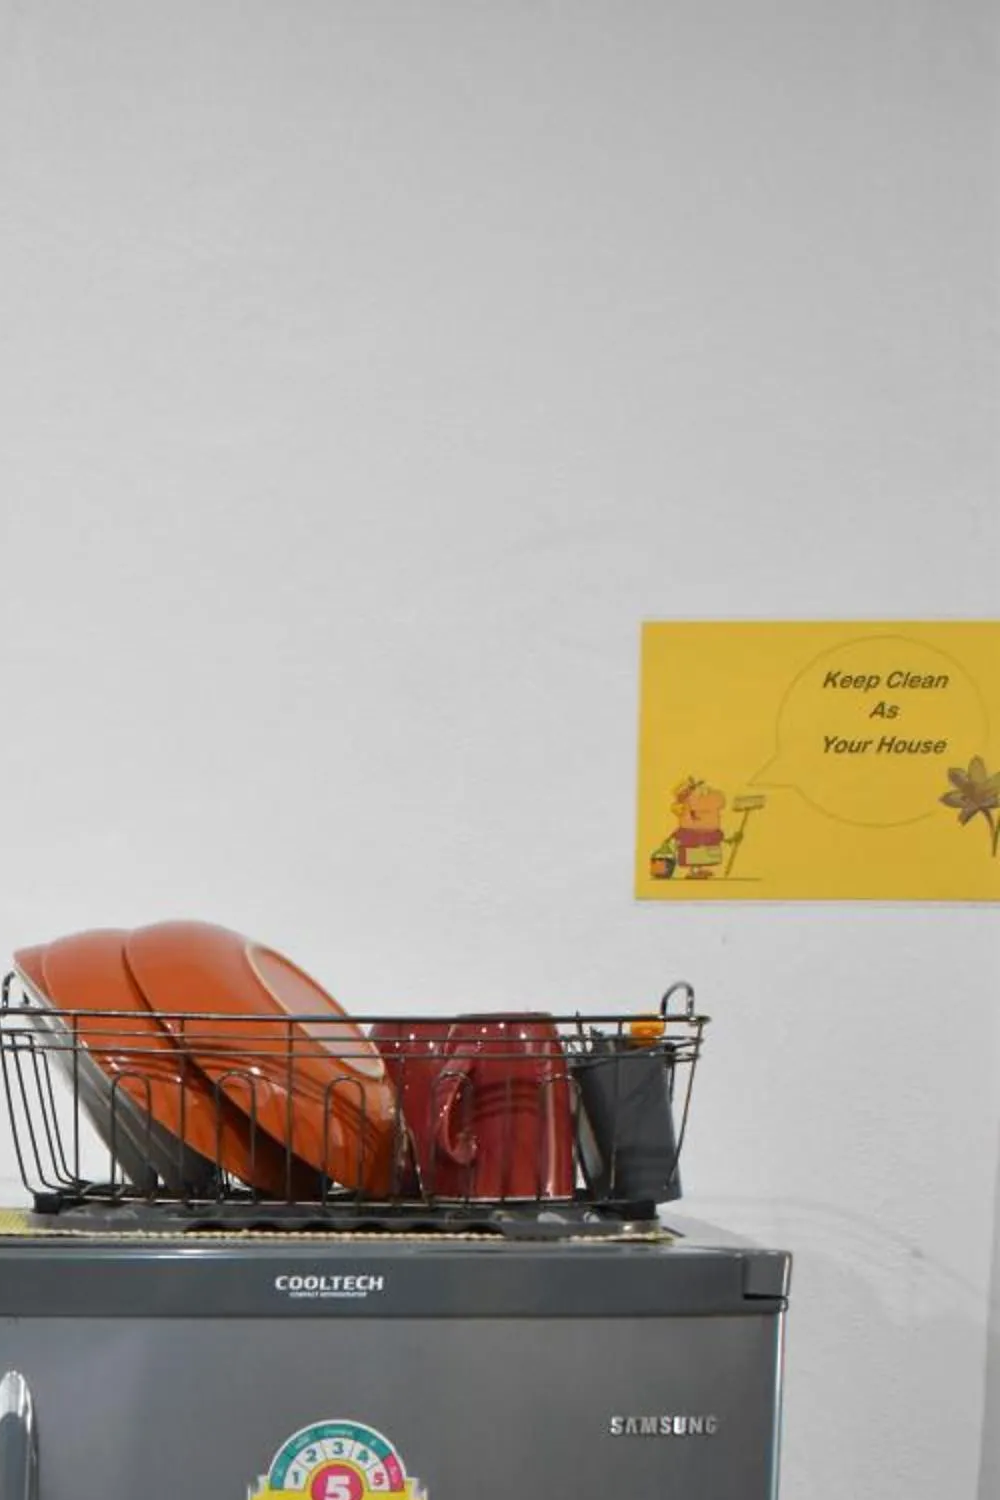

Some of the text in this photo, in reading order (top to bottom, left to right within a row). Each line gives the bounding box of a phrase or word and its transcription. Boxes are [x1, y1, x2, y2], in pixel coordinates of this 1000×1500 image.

[823, 670, 950, 692] Keep Clean
[869, 701, 900, 719] As
[823, 736, 948, 754] Your House
[275, 1275, 384, 1290] COOLTECH
[610, 1416, 717, 1434] SAMSUNG
[293, 1471, 299, 1485] 1
[306, 1449, 317, 1462] 2
[333, 1442, 344, 1455] 3
[373, 1472, 384, 1485] 5
